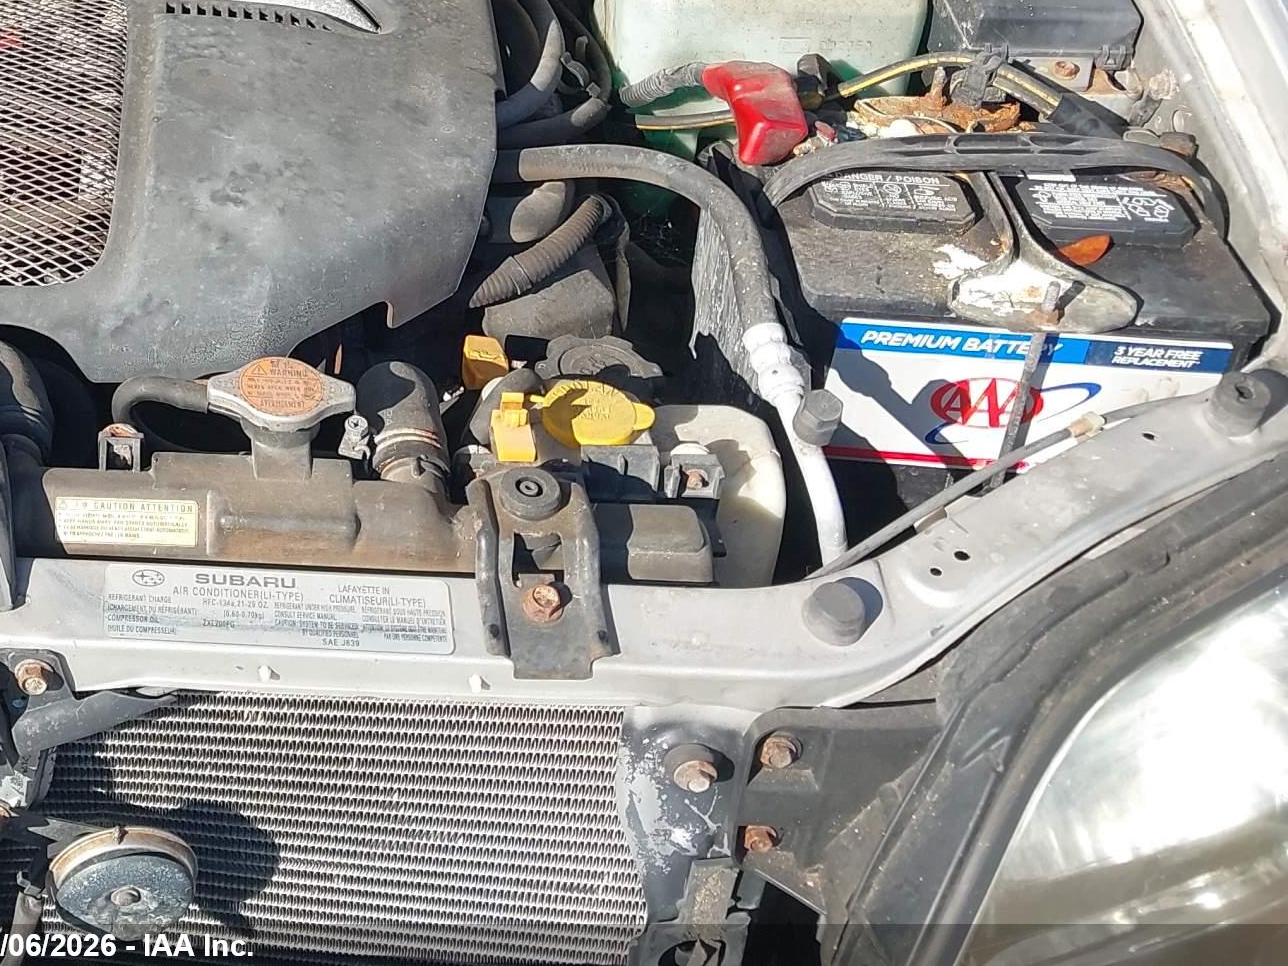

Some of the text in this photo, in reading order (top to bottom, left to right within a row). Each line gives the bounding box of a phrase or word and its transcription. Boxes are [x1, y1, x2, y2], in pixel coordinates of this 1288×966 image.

[895, 176, 940, 185] POISON
[861, 330, 1063, 356] PREMIUM BATTEY
[1114, 346, 1204, 361] 3 YEAR FREE
[270, 369, 308, 378] WARNING
[94, 501, 136, 511] CAUTION
[140, 503, 193, 513] ATTENTION
[195, 573, 296, 589] SUBARU
[173, 586, 304, 602] AIR CONDITIONER(LI-TYPE)
[338, 585, 390, 595] LAFAYETTE IN
[108, 593, 172, 604] REFRIGERANT CHARGE
[329, 595, 426, 609] CLIMATISEUR(LI-TYPE)
[148, 605, 157, 614] DU
[305, 603, 320, 611] UNDER
[107, 614, 148, 623] COMPRESSOR
[274, 610, 296, 618] CONSULT
[296, 611, 316, 619] SERVICE
[126, 625, 135, 633] DU
[327, 621, 334, 629] BE
[322, 638, 339, 646] SAE
